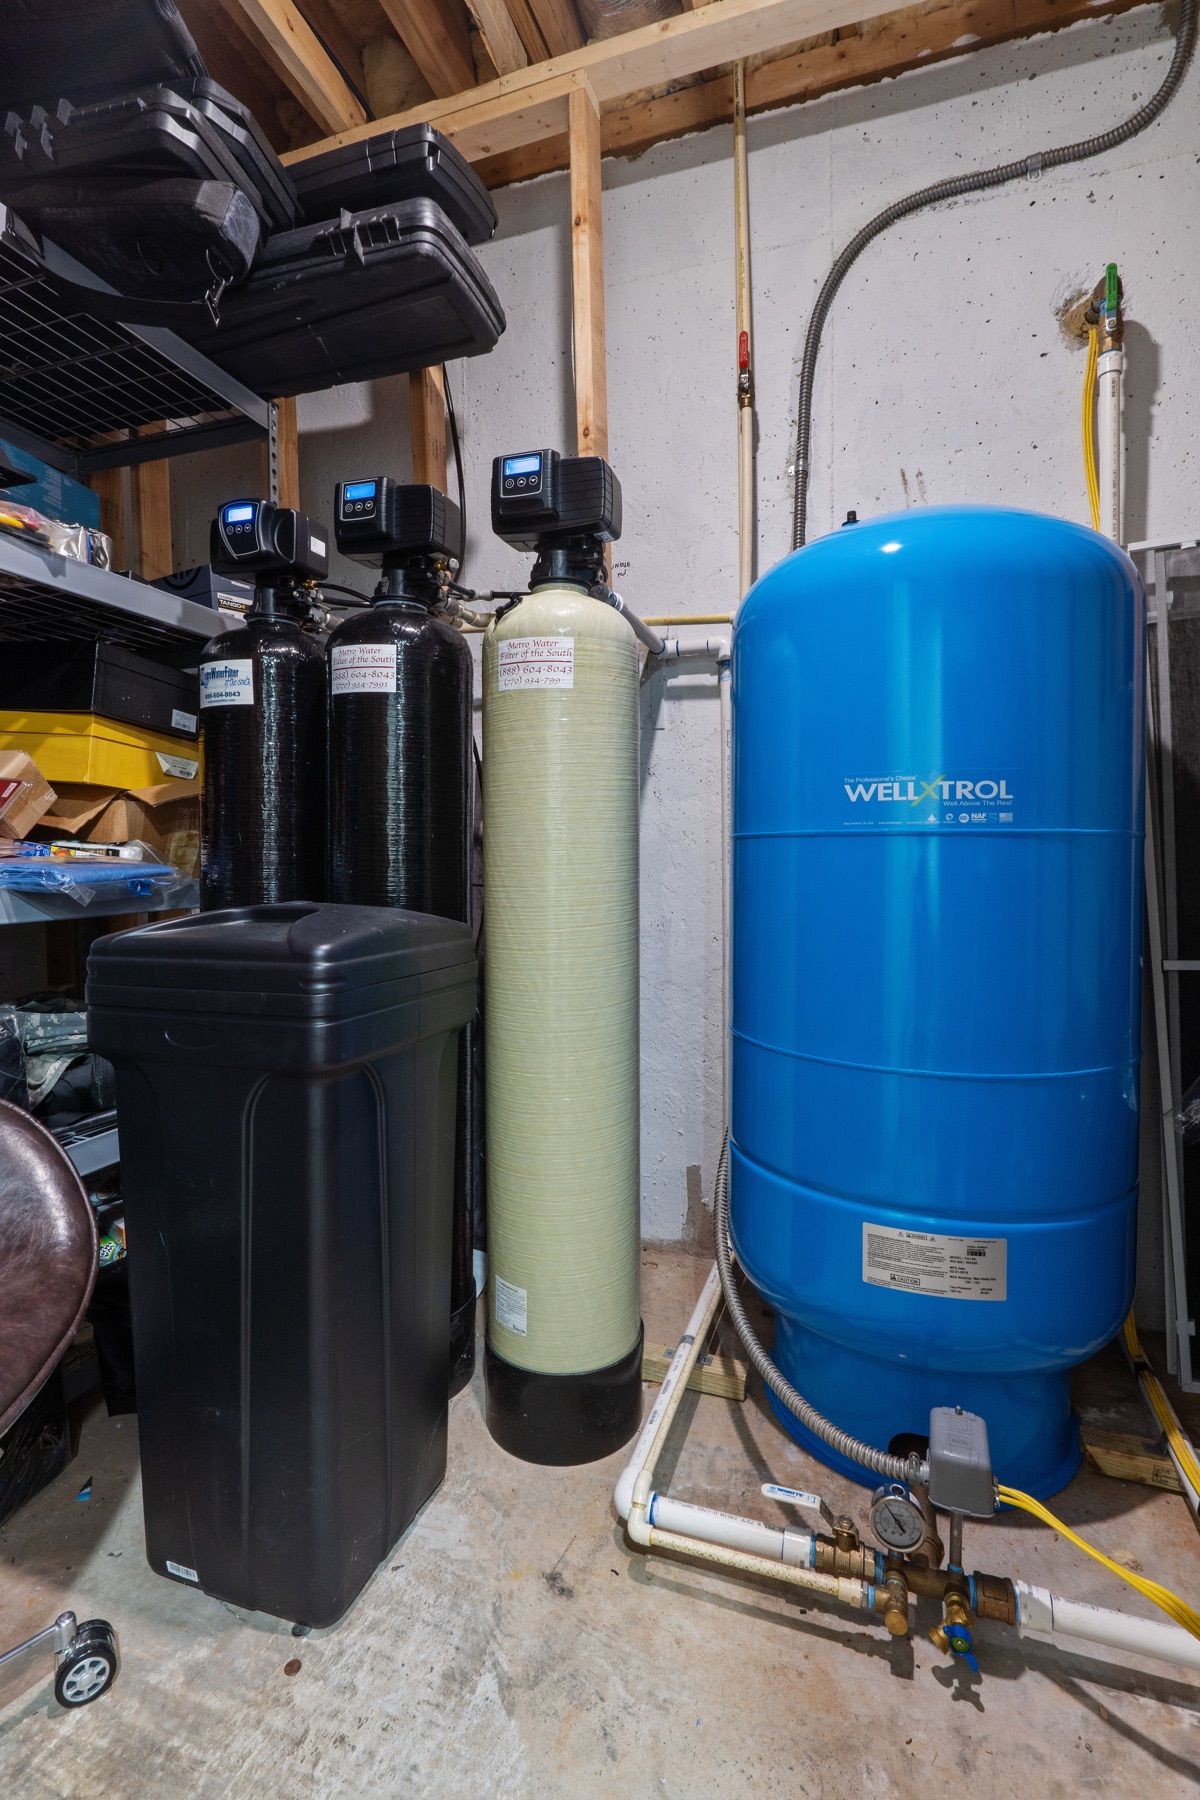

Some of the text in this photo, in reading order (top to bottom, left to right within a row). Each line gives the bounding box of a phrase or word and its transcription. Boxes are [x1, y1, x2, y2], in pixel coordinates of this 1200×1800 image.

[506, 639, 559, 650] Metro Water
[357, 654, 368, 663] the
[370, 653, 395, 663] South
[499, 648, 572, 661] Filter of the South
[350, 670, 395, 679] 604-8043
[499, 664, 573, 677] (888) 604-8043
